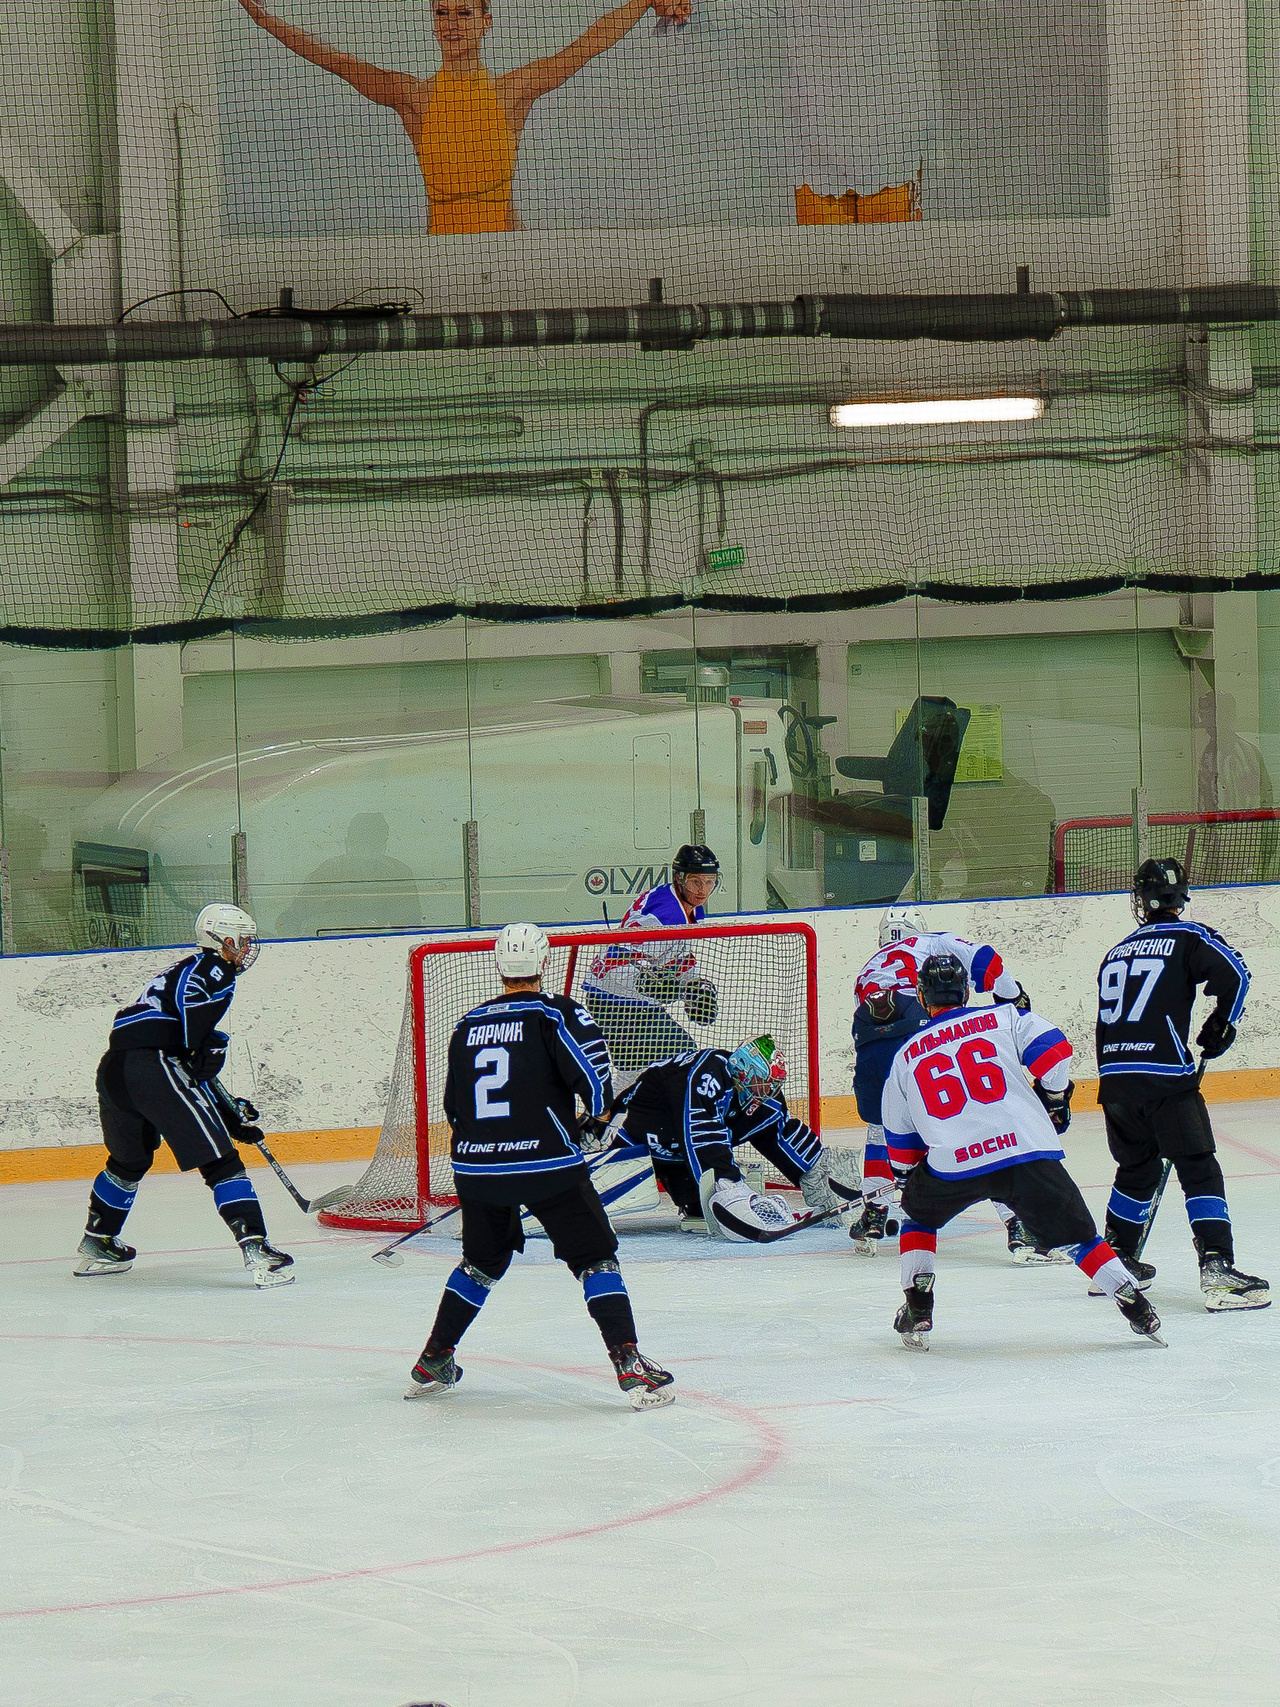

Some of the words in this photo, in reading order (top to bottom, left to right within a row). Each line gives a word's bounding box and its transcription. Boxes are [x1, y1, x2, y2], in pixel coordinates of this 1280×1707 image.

[512, 943, 519, 952] 2
[890, 929, 902, 941] 91
[1100, 958, 1165, 1024] 97
[466, 1021, 524, 1046] БАРМИН
[903, 1013, 999, 1064] ГИЛЬМАНОВ
[1120, 1042, 1156, 1052] TIMER
[475, 1047, 510, 1119] 2
[696, 1073, 721, 1098] 35
[913, 1037, 1008, 1121] 66
[468, 1142, 495, 1153] ONE
[497, 1139, 540, 1152] TIMER
[954, 1132, 1017, 1164] SOCHI
[830, 1183, 897, 1214] TRUE
